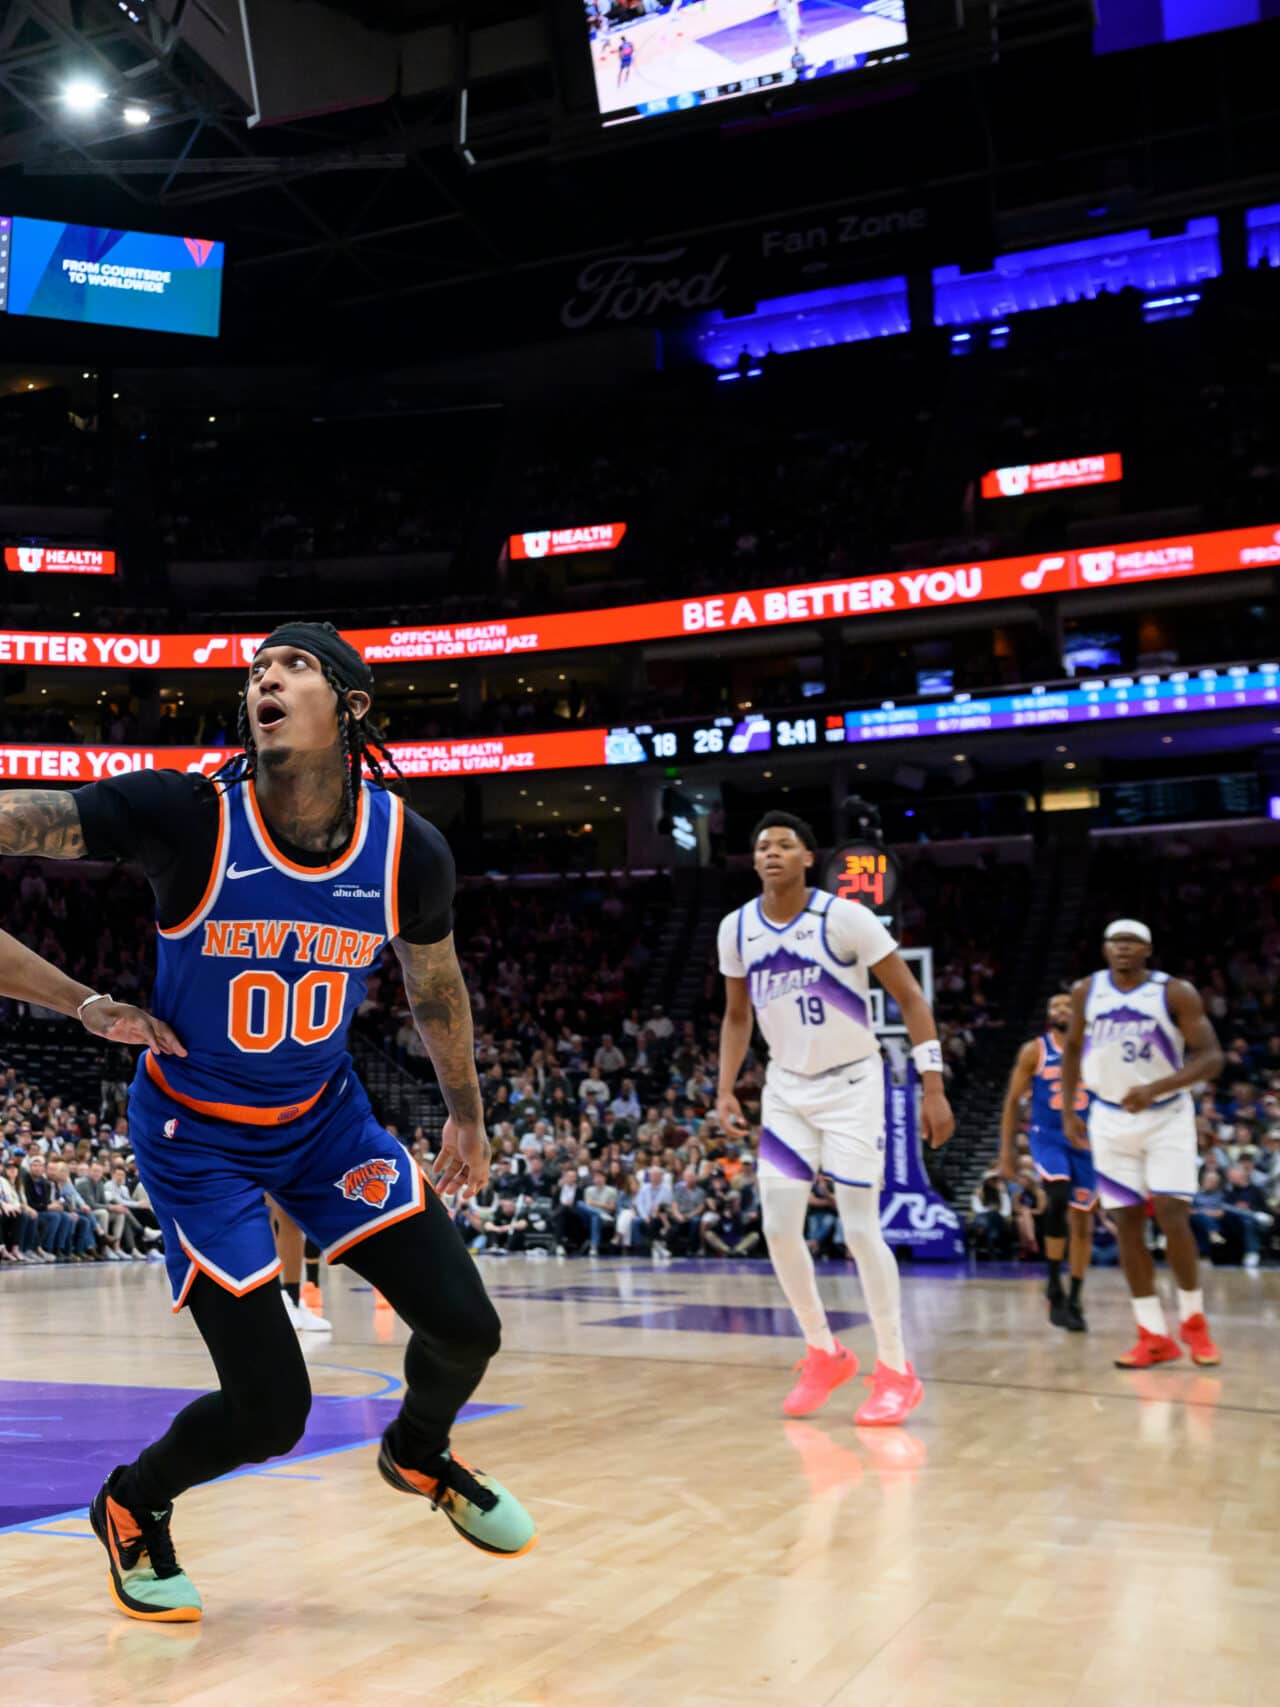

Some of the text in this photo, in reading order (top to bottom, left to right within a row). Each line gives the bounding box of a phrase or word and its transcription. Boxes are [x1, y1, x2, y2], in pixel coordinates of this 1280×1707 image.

[763, 208, 928, 257] Fan Zone
[62, 259, 171, 283] FROM COURTSIDE
[68, 272, 165, 293] TO WORLDWIDE
[560, 247, 730, 329] Ford
[1031, 457, 1105, 481] HEALTH
[552, 525, 613, 545] HEALTH
[46, 550, 103, 565] HEALTH
[1116, 546, 1193, 570] HEALTH
[683, 567, 982, 630] BE A BETTER YOU
[365, 634, 538, 659] PROVIDER FOR UTAH JAZZ
[390, 624, 507, 645] OFFICIAL HEALTH
[93, 638, 160, 664] YOU
[451, 742, 503, 758] HEALTH
[652, 732, 677, 757] 18
[693, 728, 724, 753] 26
[777, 719, 817, 746] 3:41
[85, 752, 153, 777] YOU
[432, 757, 461, 772] FOR
[463, 755, 502, 770] UTAH
[501, 752, 534, 771] JAZZ
[332, 888, 380, 898] abu dhabi
[838, 872, 884, 905] 24
[201, 919, 386, 969] NEW YORK
[227, 969, 350, 1053] 00
[795, 996, 826, 1026] 19
[1122, 1041, 1154, 1063] 34
[345, 1160, 398, 1197] KNICKS
